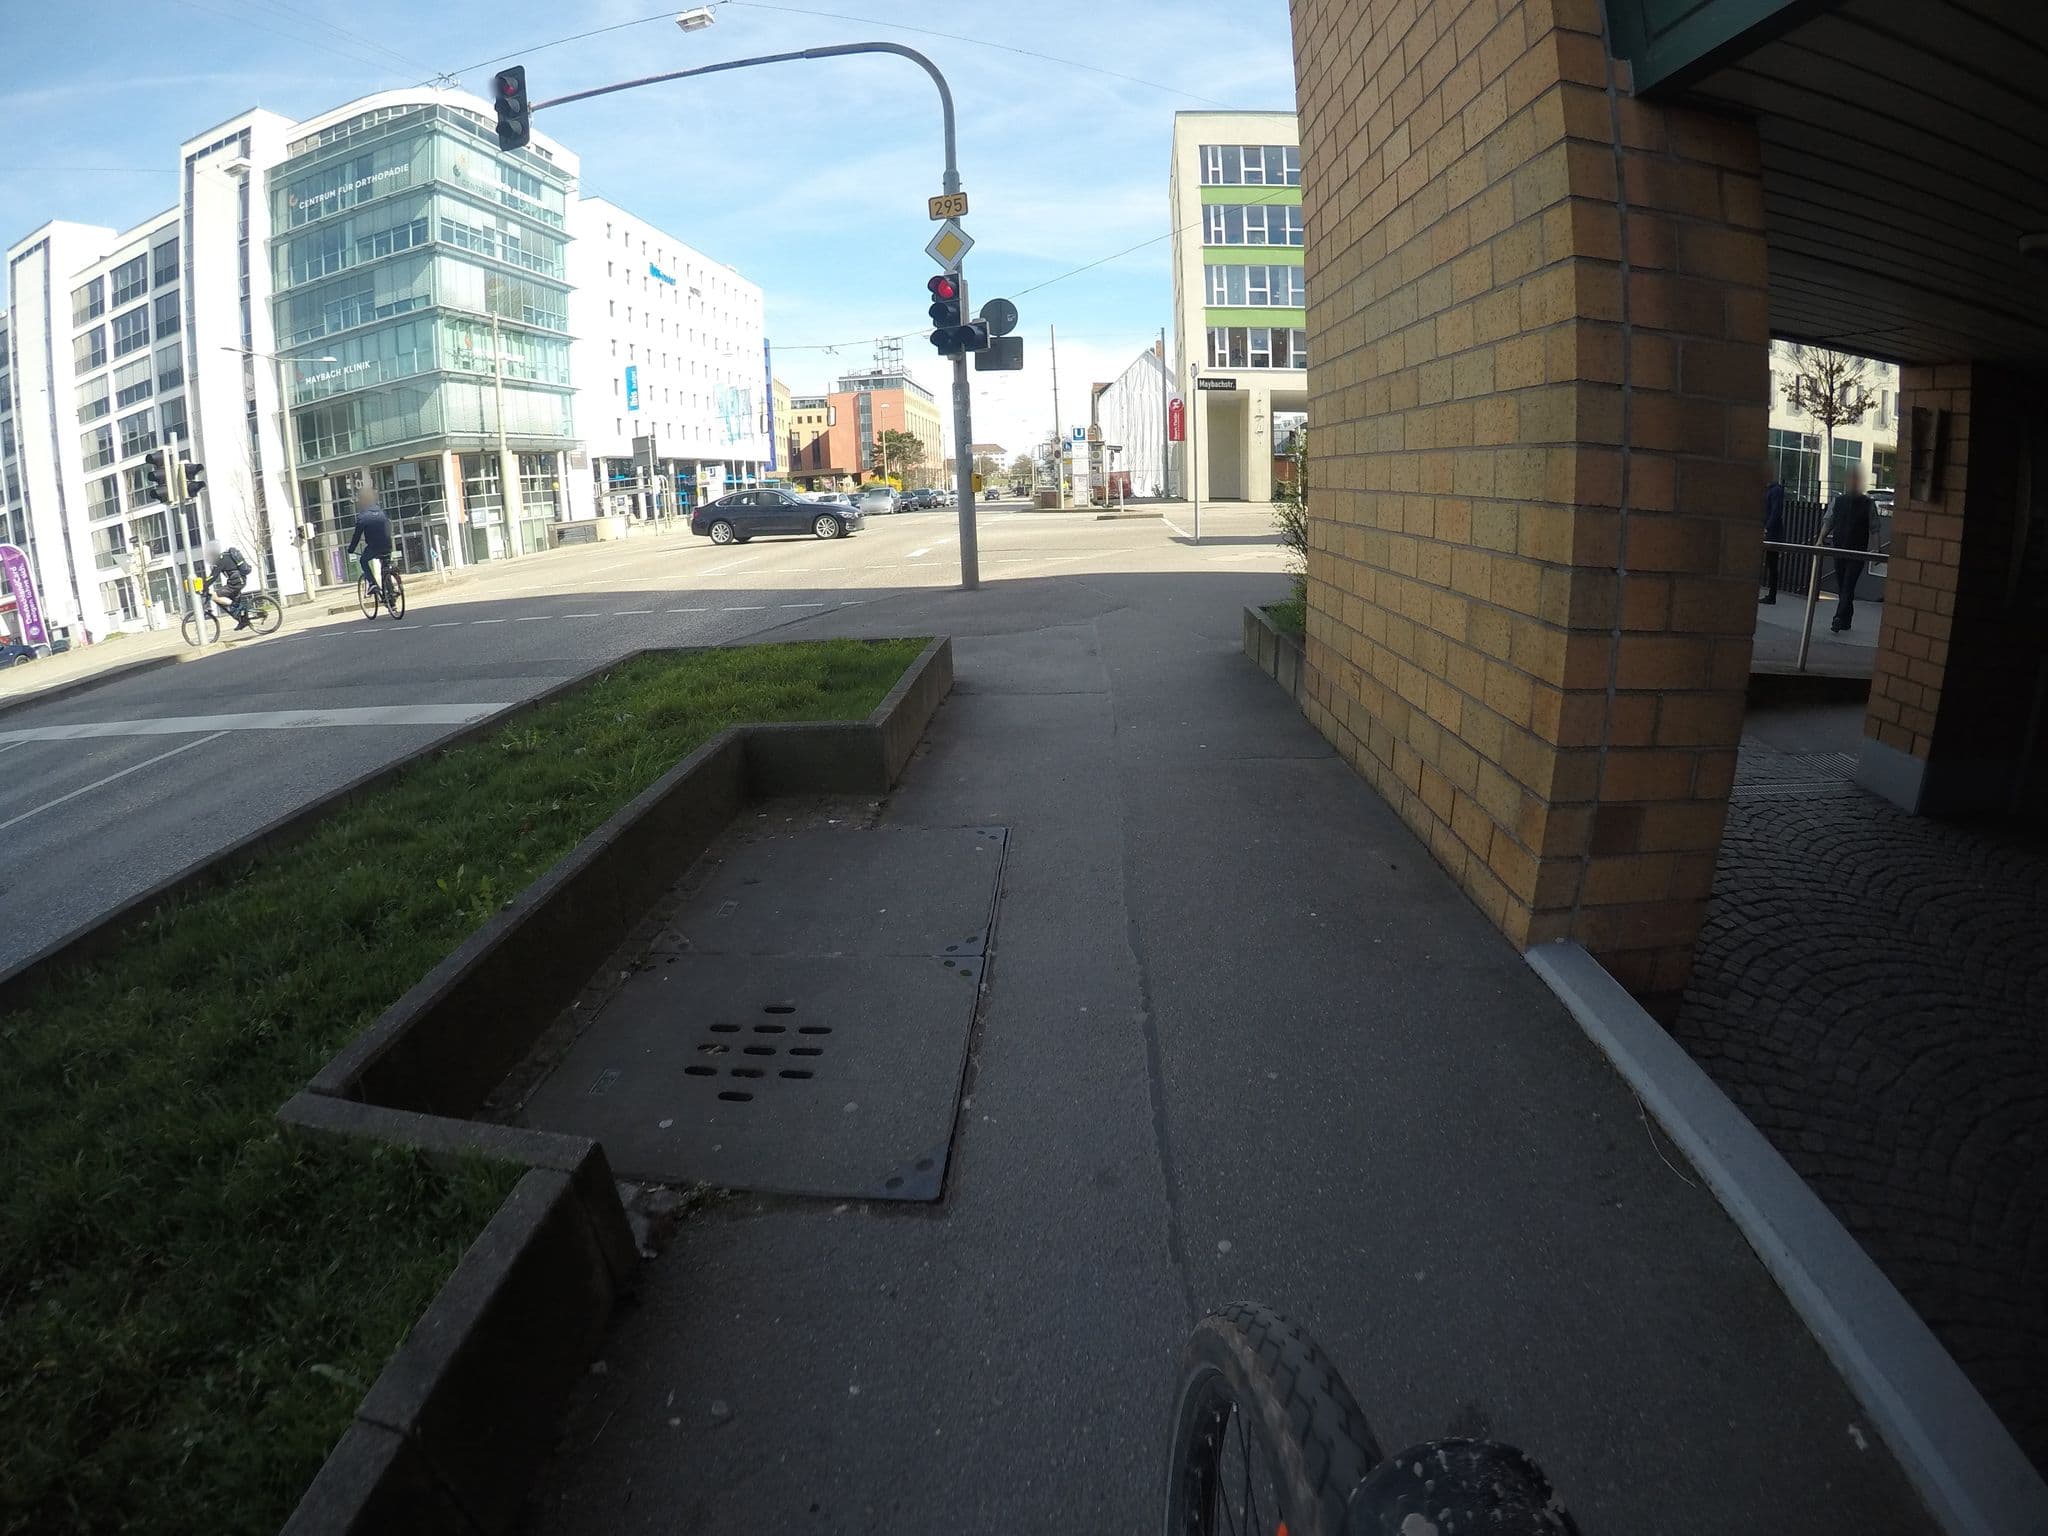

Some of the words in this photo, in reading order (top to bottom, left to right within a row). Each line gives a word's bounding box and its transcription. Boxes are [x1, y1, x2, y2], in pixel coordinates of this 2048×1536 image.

[299, 190, 336, 210] CENTRUM
[355, 163, 409, 188] ORTHOPÄDIE
[934, 197, 963, 216] 295
[305, 368, 342, 385] MAYBACH
[343, 360, 371, 374] KLINIK
[1074, 428, 1084, 438] U
